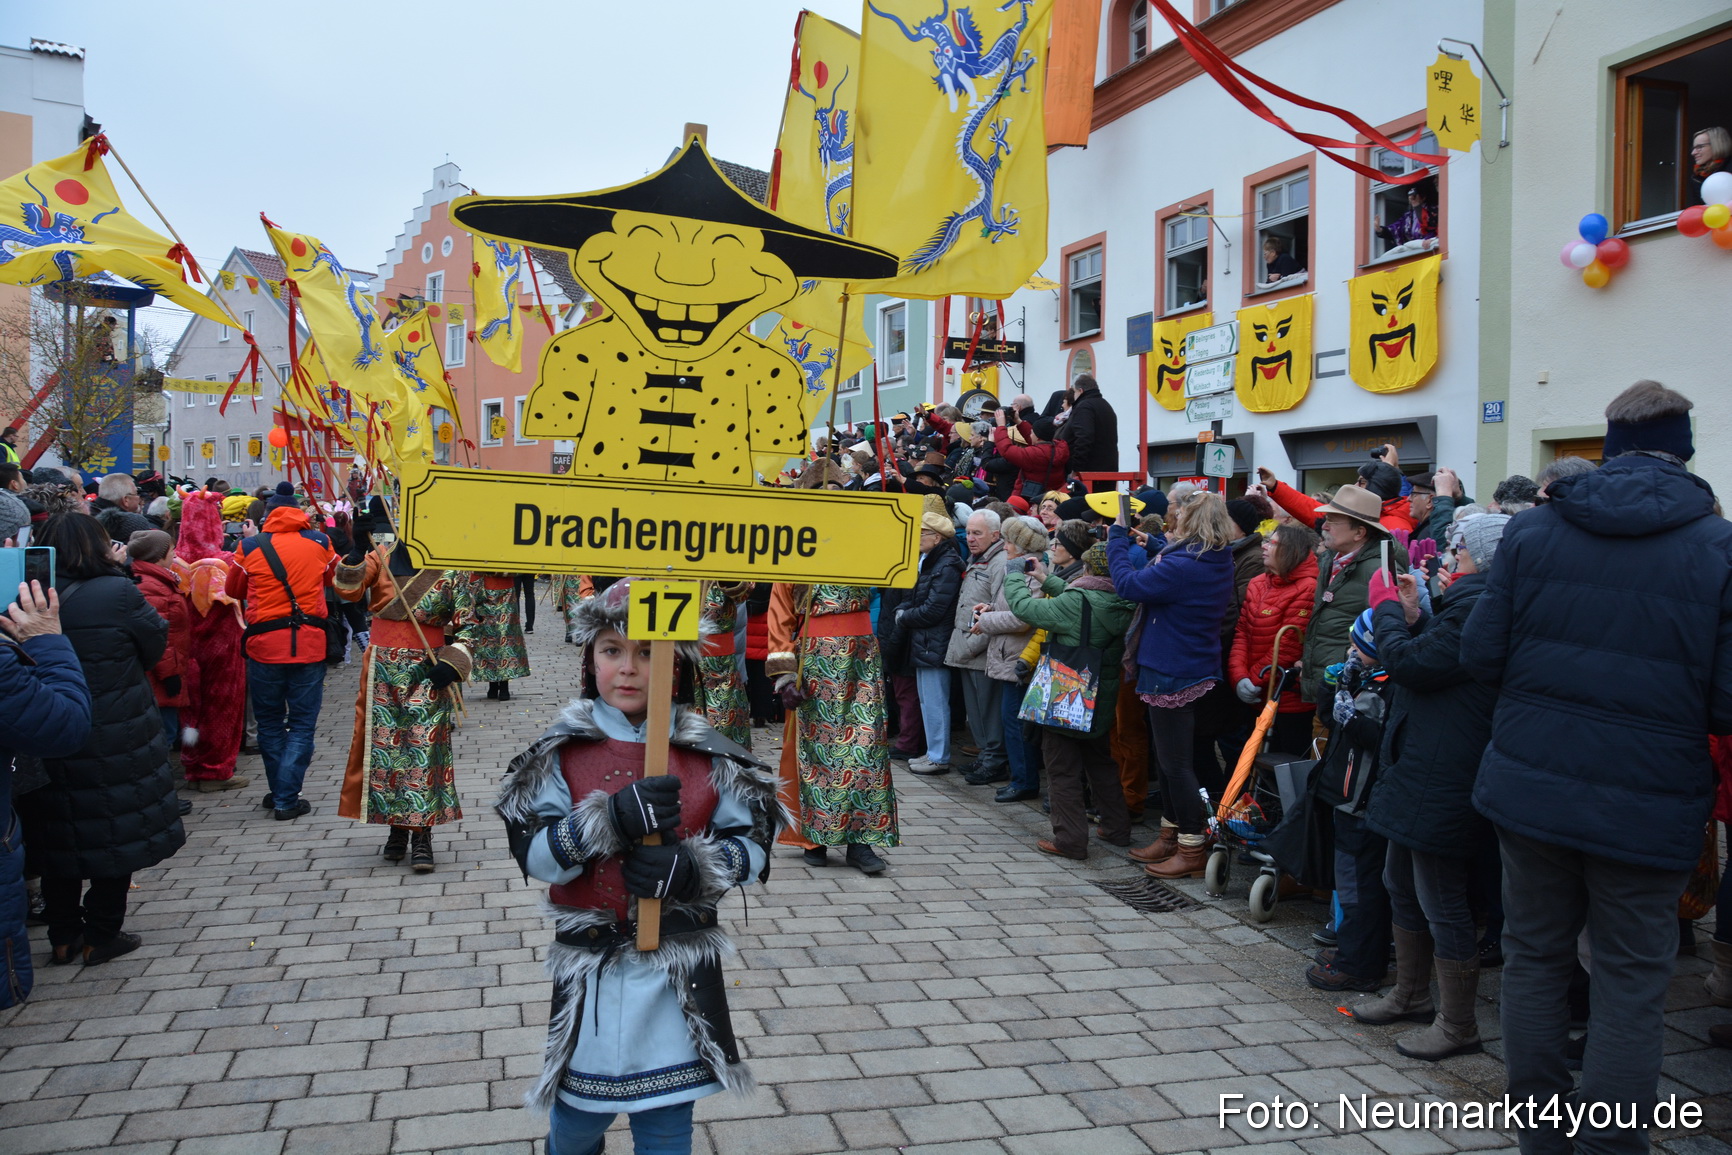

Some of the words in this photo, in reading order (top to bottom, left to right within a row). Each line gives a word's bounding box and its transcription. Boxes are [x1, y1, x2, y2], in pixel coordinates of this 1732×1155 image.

[1439, 114, 1452, 133] 人
[1486, 403, 1500, 414] 20
[553, 455, 571, 465] CAFÉ
[513, 502, 818, 565] Drachengruppe
[638, 592, 692, 633] 17
